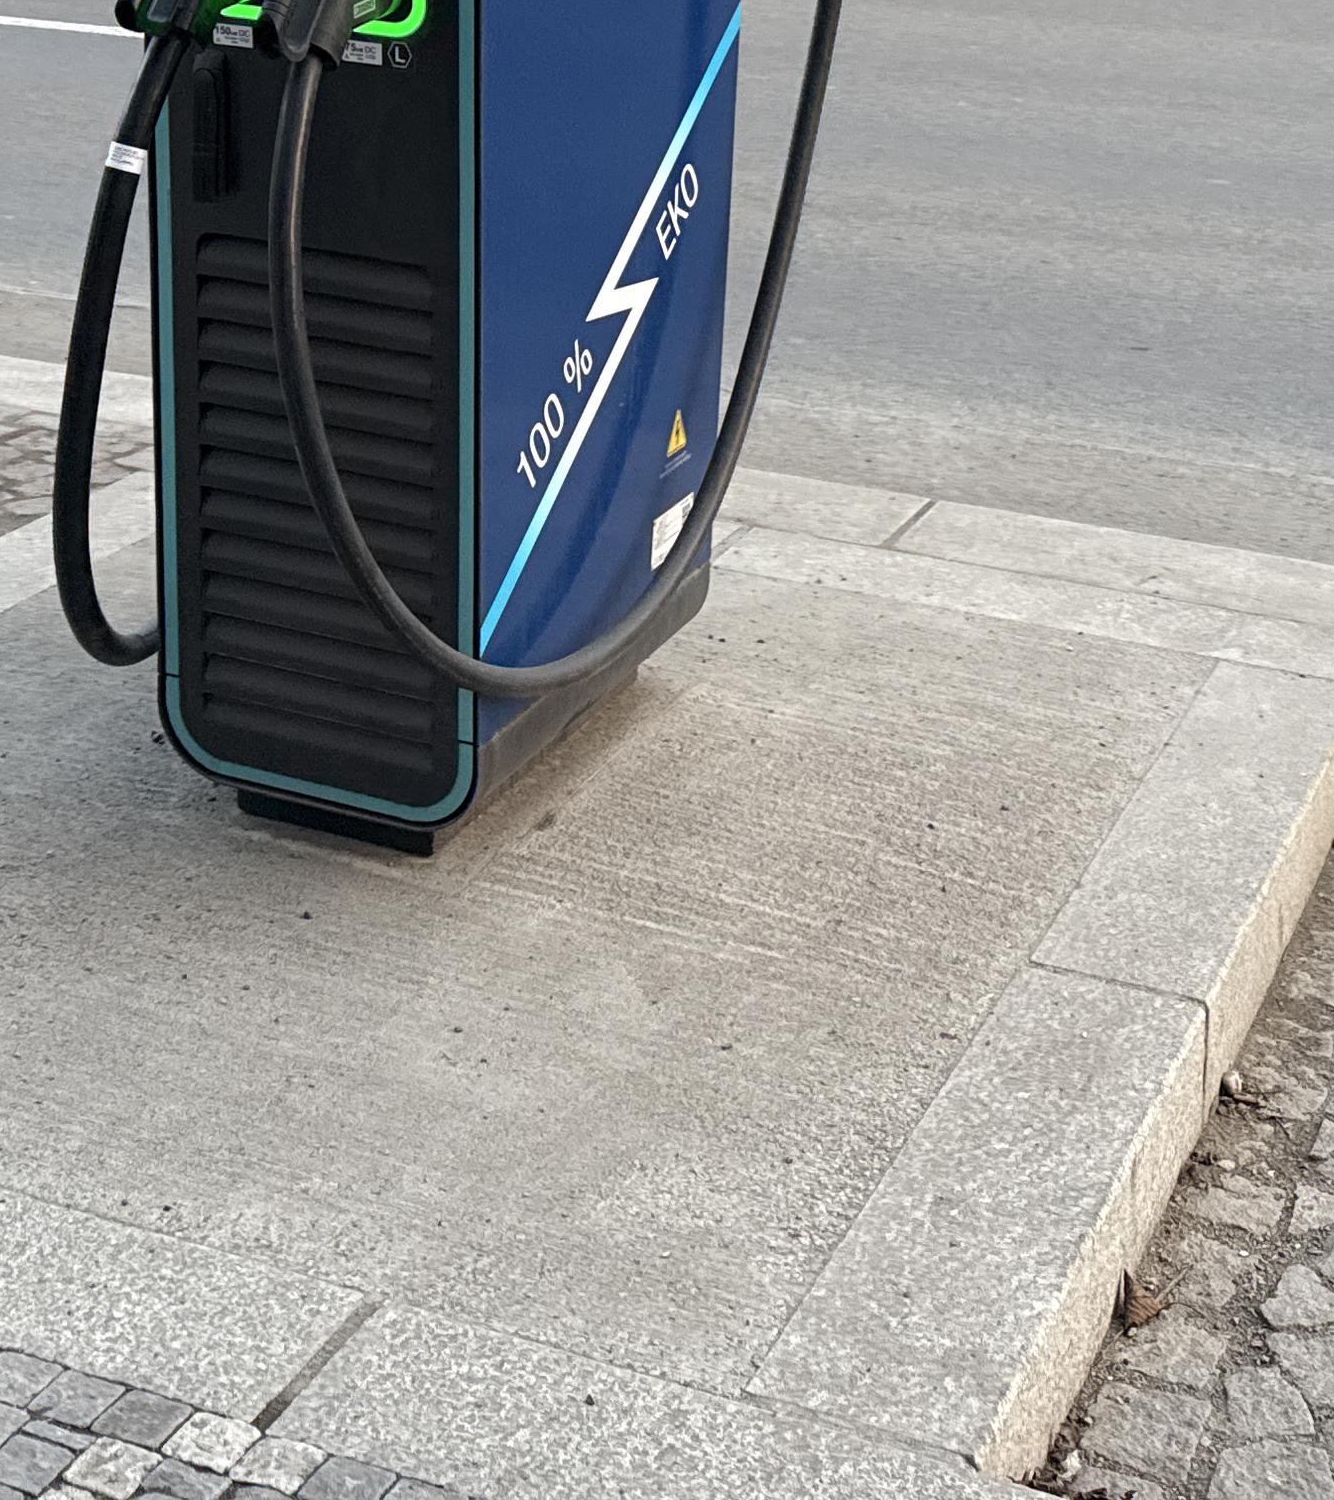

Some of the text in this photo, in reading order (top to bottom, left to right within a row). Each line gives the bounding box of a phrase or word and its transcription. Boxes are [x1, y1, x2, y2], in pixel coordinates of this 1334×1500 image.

[394, 46, 406, 63] L
[517, 163, 699, 488] 100 % EKO
